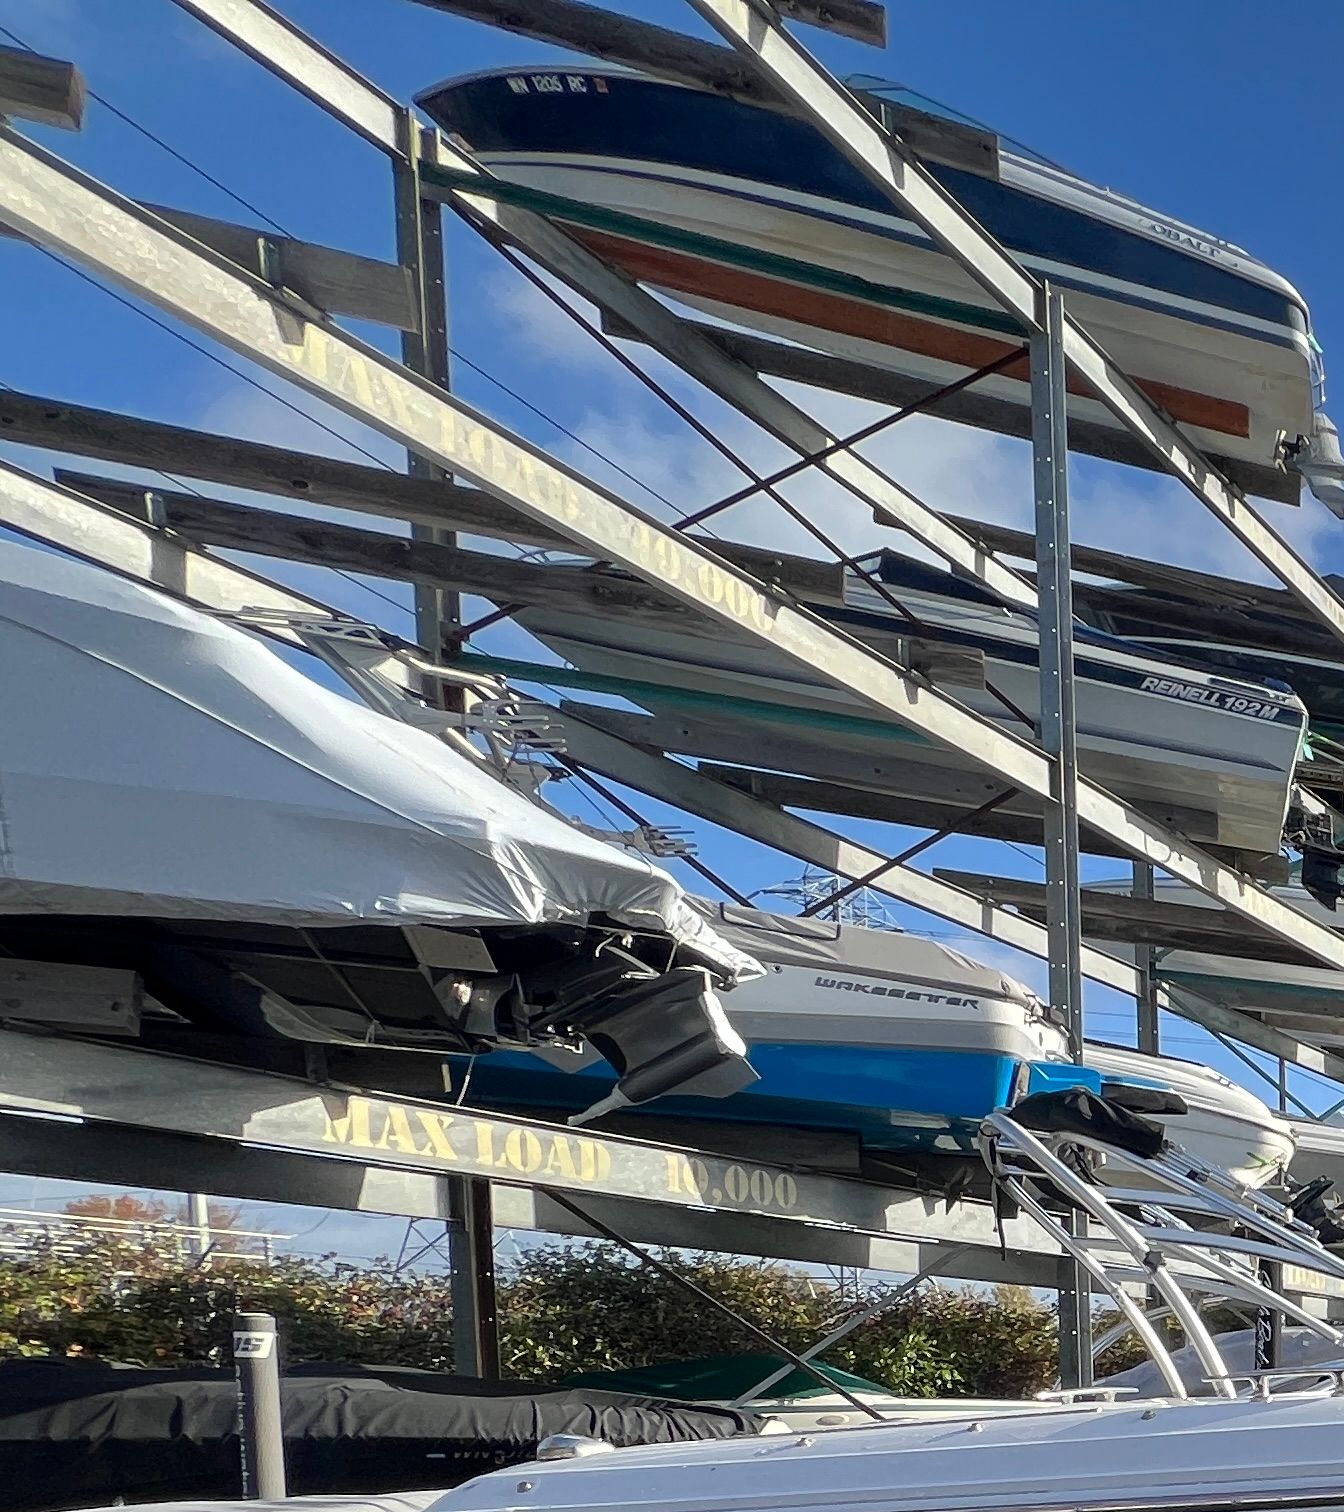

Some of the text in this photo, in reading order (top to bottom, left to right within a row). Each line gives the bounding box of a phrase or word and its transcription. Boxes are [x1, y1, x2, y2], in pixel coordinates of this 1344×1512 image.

[1140, 677, 1280, 720] REINELL 192M
[321, 1095, 797, 1208] MAX LOAD 10,000
